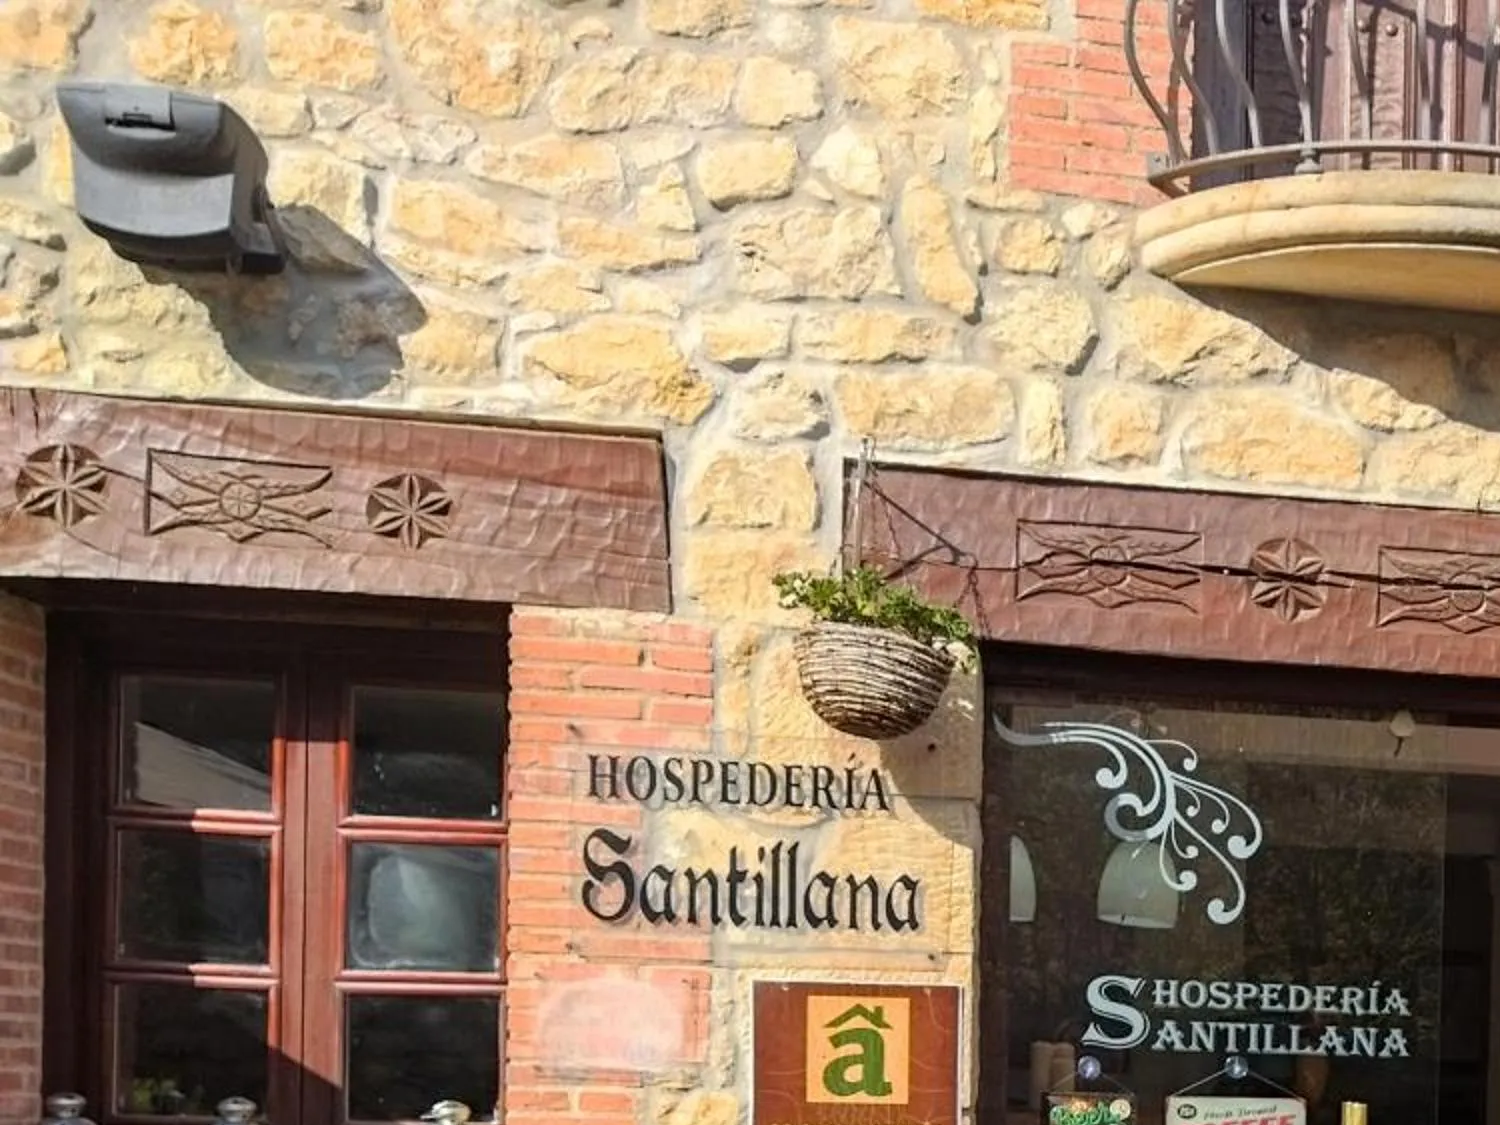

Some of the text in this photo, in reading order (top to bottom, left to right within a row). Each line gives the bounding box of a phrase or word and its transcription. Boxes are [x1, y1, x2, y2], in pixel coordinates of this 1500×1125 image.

[588, 753, 890, 811] HOSPEDERÍA
[581, 828, 921, 932] Santillana
[1082, 975, 1410, 1057] SANTILLANA
[1151, 980, 1411, 1016] HOSPEDERÍA
